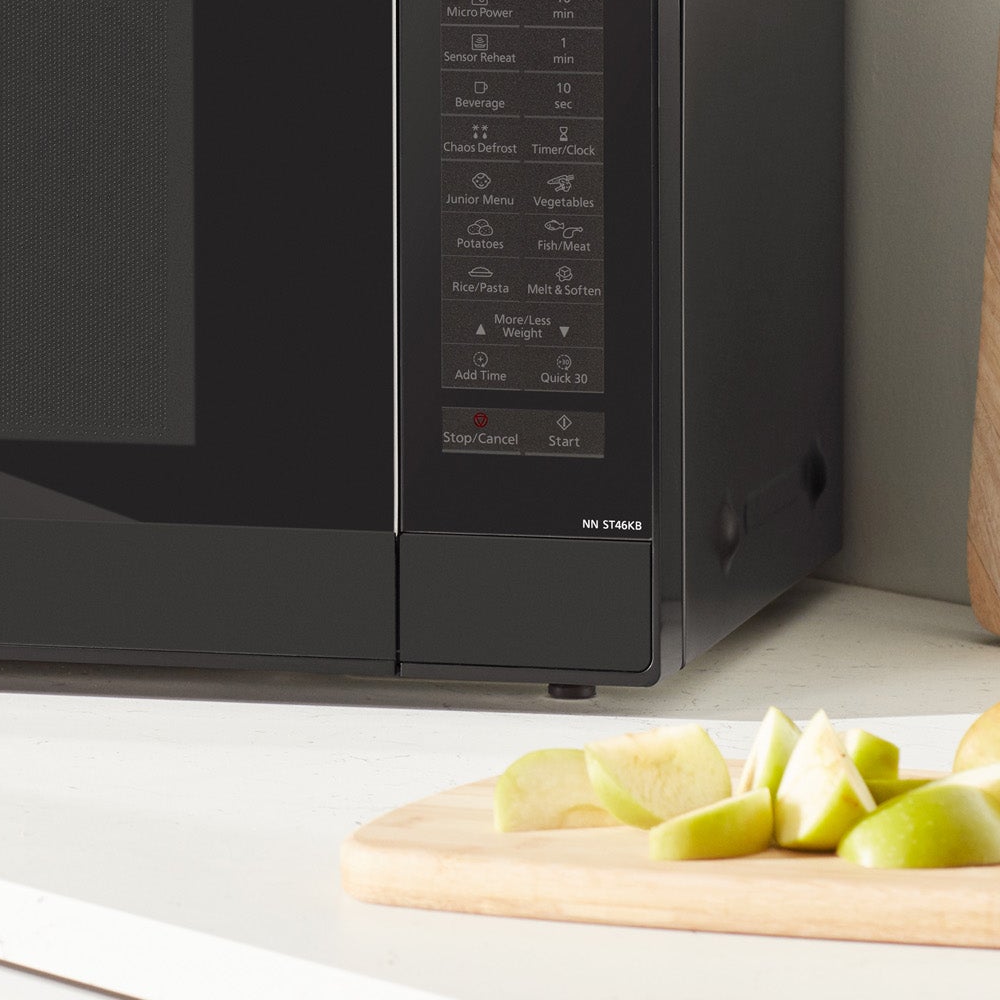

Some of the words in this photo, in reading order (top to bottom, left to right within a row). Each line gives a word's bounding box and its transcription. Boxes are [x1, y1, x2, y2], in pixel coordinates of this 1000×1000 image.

[446, 7, 479, 18] Micro
[480, 7, 513, 18] Power
[553, 9, 574, 19] min
[560, 37, 566, 48] 1
[444, 52, 478, 63] Sensor
[480, 52, 516, 63] Reheat
[553, 54, 574, 64] min
[556, 82, 571, 94] 10
[455, 97, 505, 110] Beverage
[554, 99, 573, 109] sec
[443, 141, 475, 153] Chaos
[477, 142, 517, 154] Defrost
[532, 144, 595, 156] Timer/Clock
[446, 194, 479, 205] Junior
[482, 194, 514, 206] Menu
[533, 196, 594, 209] Vegetables
[457, 238, 504, 249] Potatoes
[537, 240, 591, 252] Fish/Meat
[452, 281, 509, 293] Rice/Pasta
[527, 283, 552, 295] Melt
[554, 284, 563, 295] &
[564, 284, 601, 296] Soften
[494, 314, 551, 326] More/Less
[502, 327, 543, 341] Weight
[455, 370, 477, 380] Add
[480, 370, 507, 381] Time
[540, 373, 571, 384] Quick
[574, 373, 588, 384] 30
[443, 432, 518, 446] Stop/Cancel
[548, 435, 580, 447] Start
[582, 519, 599, 529] NN
[602, 519, 642, 531] ST46KB
